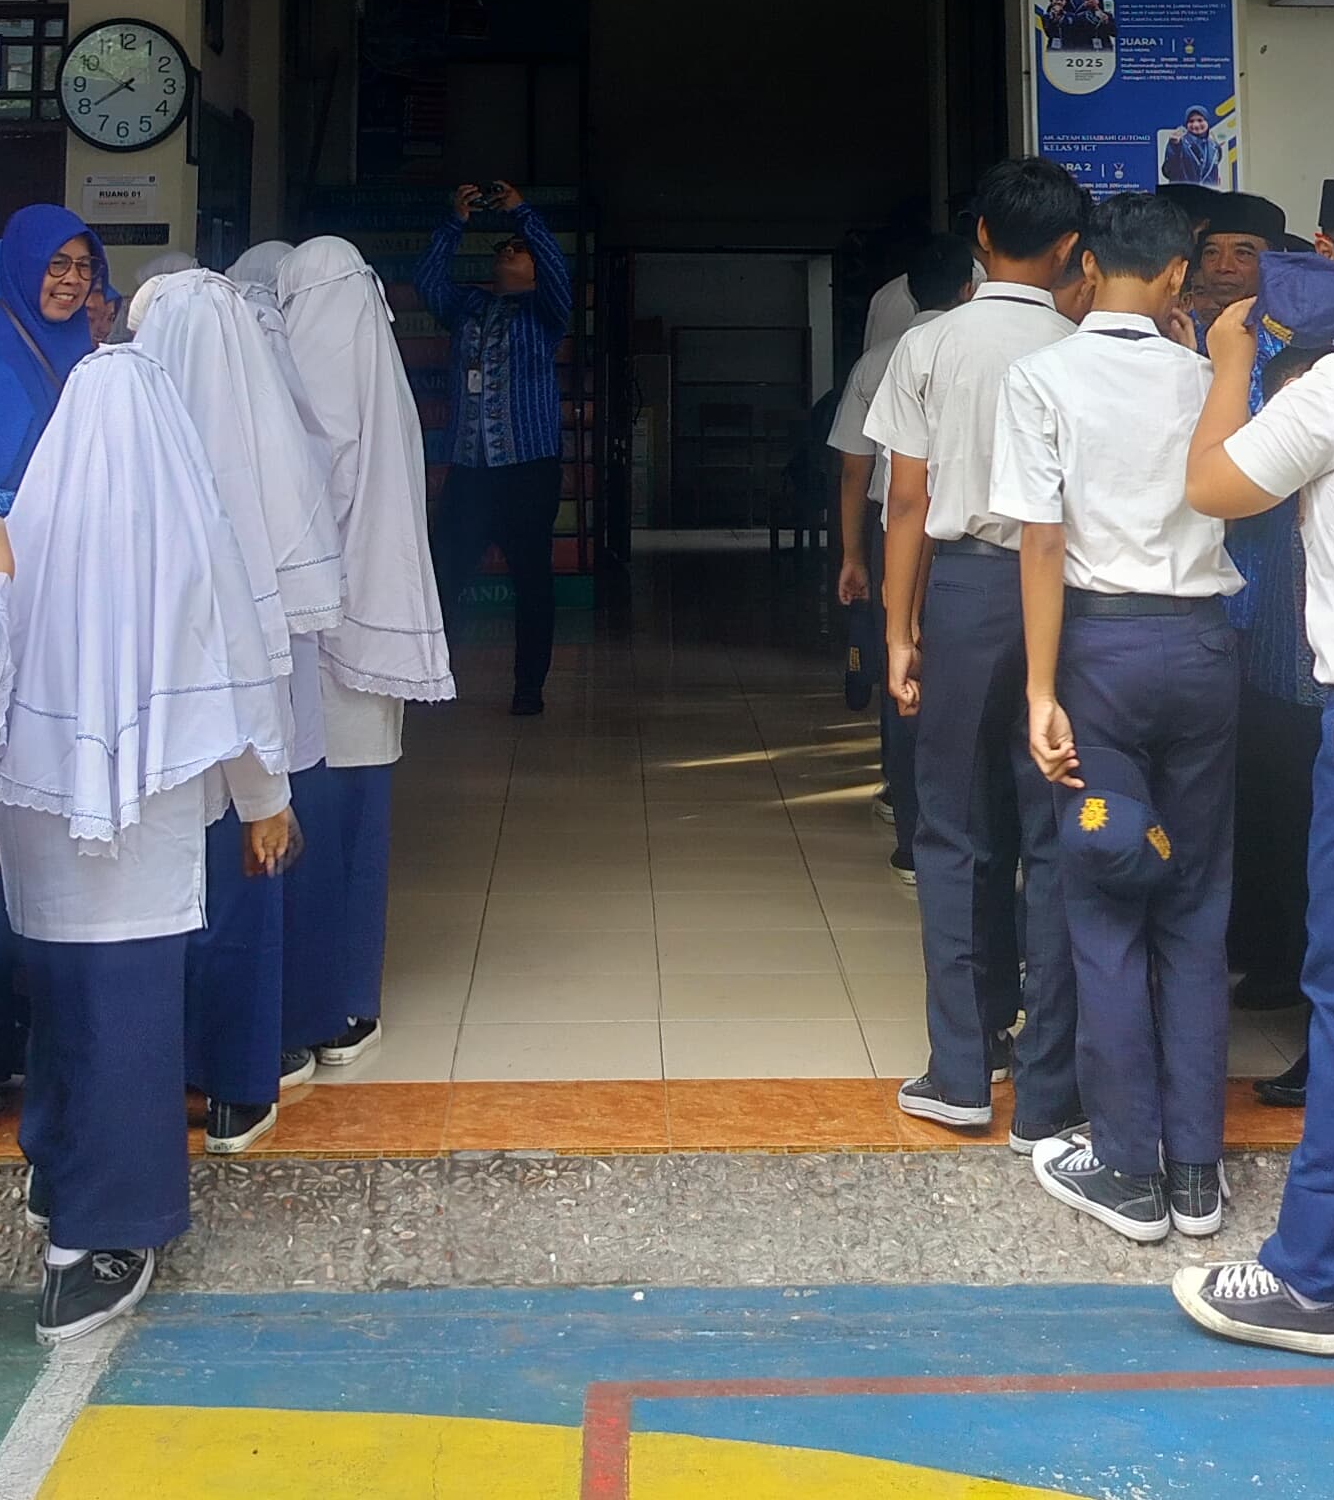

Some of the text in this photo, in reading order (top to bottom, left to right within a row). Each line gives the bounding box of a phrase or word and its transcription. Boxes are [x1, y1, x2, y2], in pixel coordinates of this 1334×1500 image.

[119, 33, 137, 49] 12
[145, 40, 153, 56] 1
[1120, 37, 1164, 46] JUARA 1
[79, 55, 101, 72] 10
[158, 57, 172, 73] 2
[1066, 58, 1103, 68] 2025
[73, 76, 87, 92] 9
[163, 78, 177, 94] 3
[78, 99, 92, 115] 8
[154, 101, 169, 117] 4
[97, 115, 110, 132] 7
[116, 121, 130, 138] 6
[139, 116, 152, 133] 5
[1043, 144, 1098, 152] KELAS 9 ICT
[1083, 162, 1092, 172] 2
[99, 190, 129, 198] RUANG
